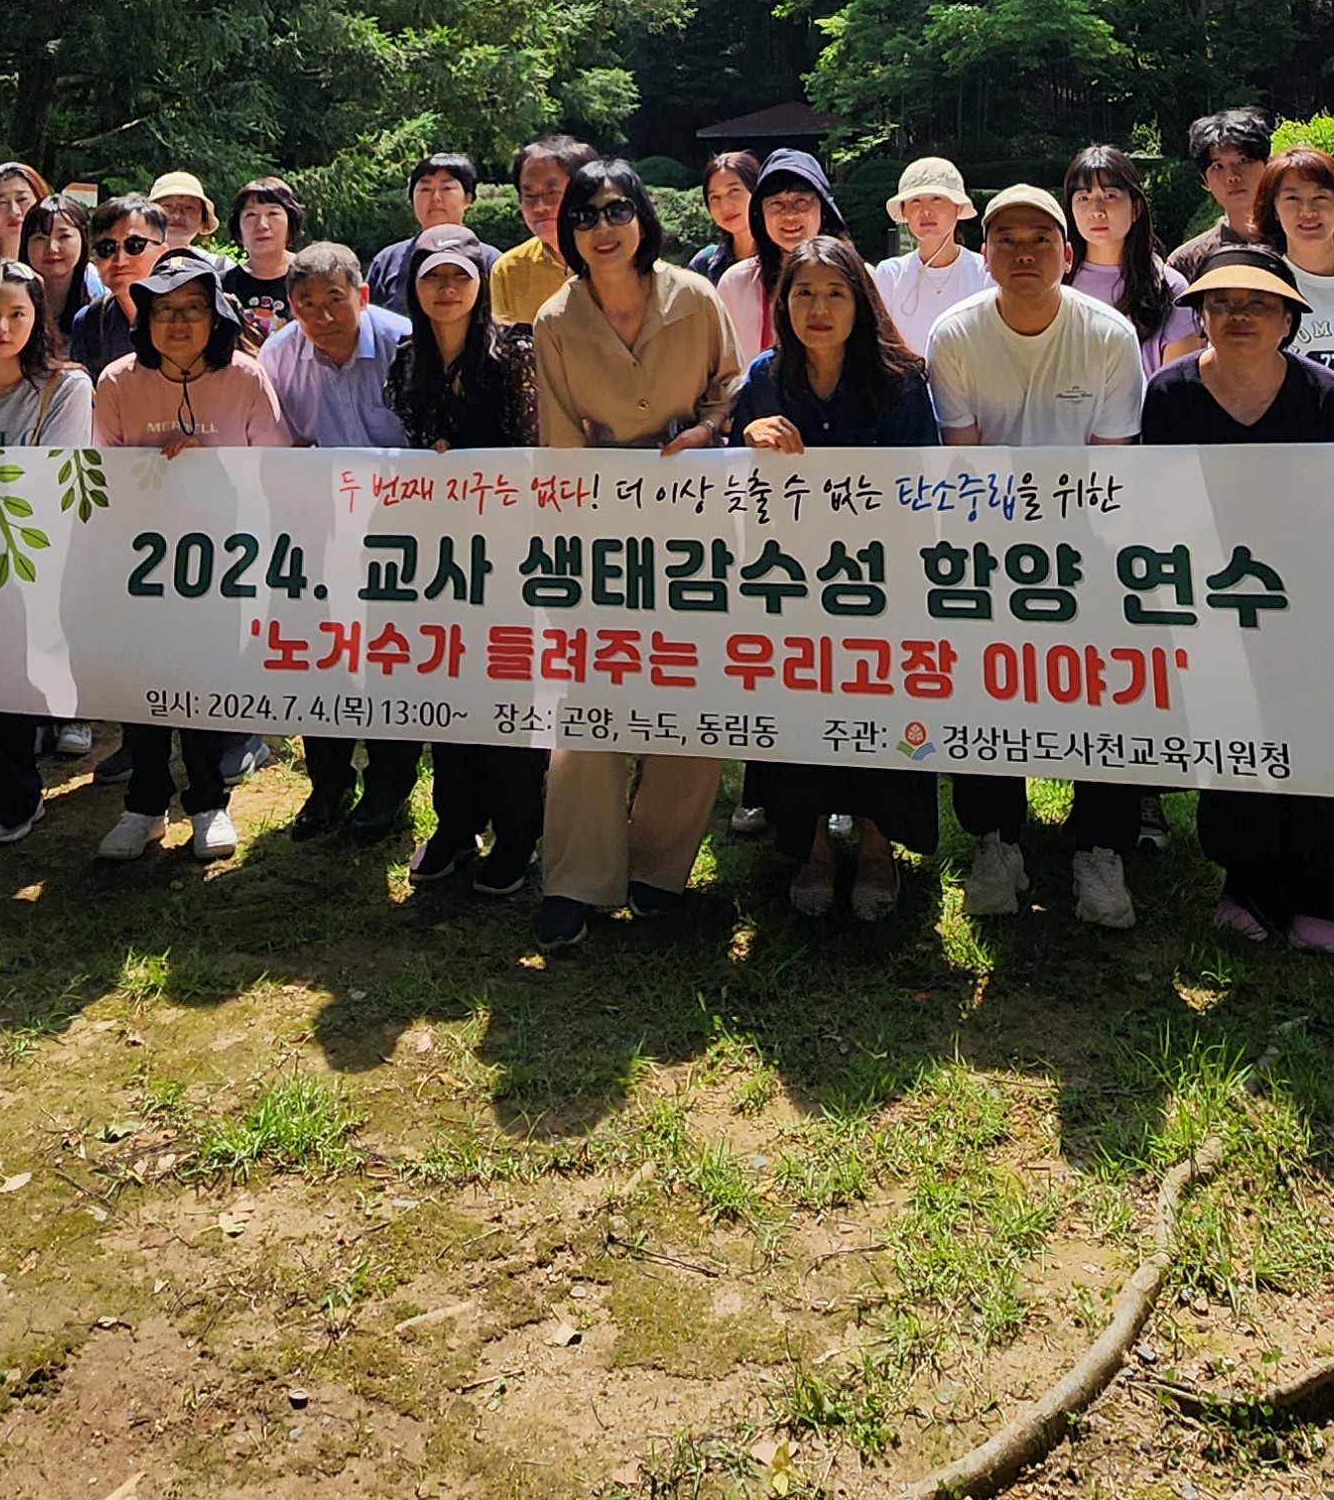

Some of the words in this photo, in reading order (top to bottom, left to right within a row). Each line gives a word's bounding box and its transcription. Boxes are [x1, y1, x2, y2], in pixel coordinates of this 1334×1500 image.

[340, 471, 360, 512] 두
[373, 475, 434, 506] 번째
[447, 472, 519, 515] 지구는
[531, 474, 599, 512] 없다!
[616, 478, 643, 509] 더
[656, 476, 714, 514] 이상
[724, 468, 772, 524] 늦출
[784, 474, 810, 521] 수
[824, 475, 883, 515] 없는
[895, 473, 1042, 522] 탄소중립을
[1053, 472, 1123, 519] 위한
[128, 532, 328, 600] 2024.
[358, 535, 493, 605] 교사
[519, 536, 886, 616] 생태감수성
[920, 541, 1082, 622] 함양
[1117, 545, 1289, 628] 연수
[487, 627, 698, 687] 들려주는
[724, 634, 957, 699] 우리고장
[146, 690, 198, 718] 일시:
[494, 704, 551, 733] 장소:
[561, 708, 618, 742] 곤양,
[628, 710, 686, 746] 늑도,
[697, 714, 778, 748] 동림동
[823, 720, 886, 753] 주관:
[942, 725, 1290, 780] 경상남도사천교육지원청
